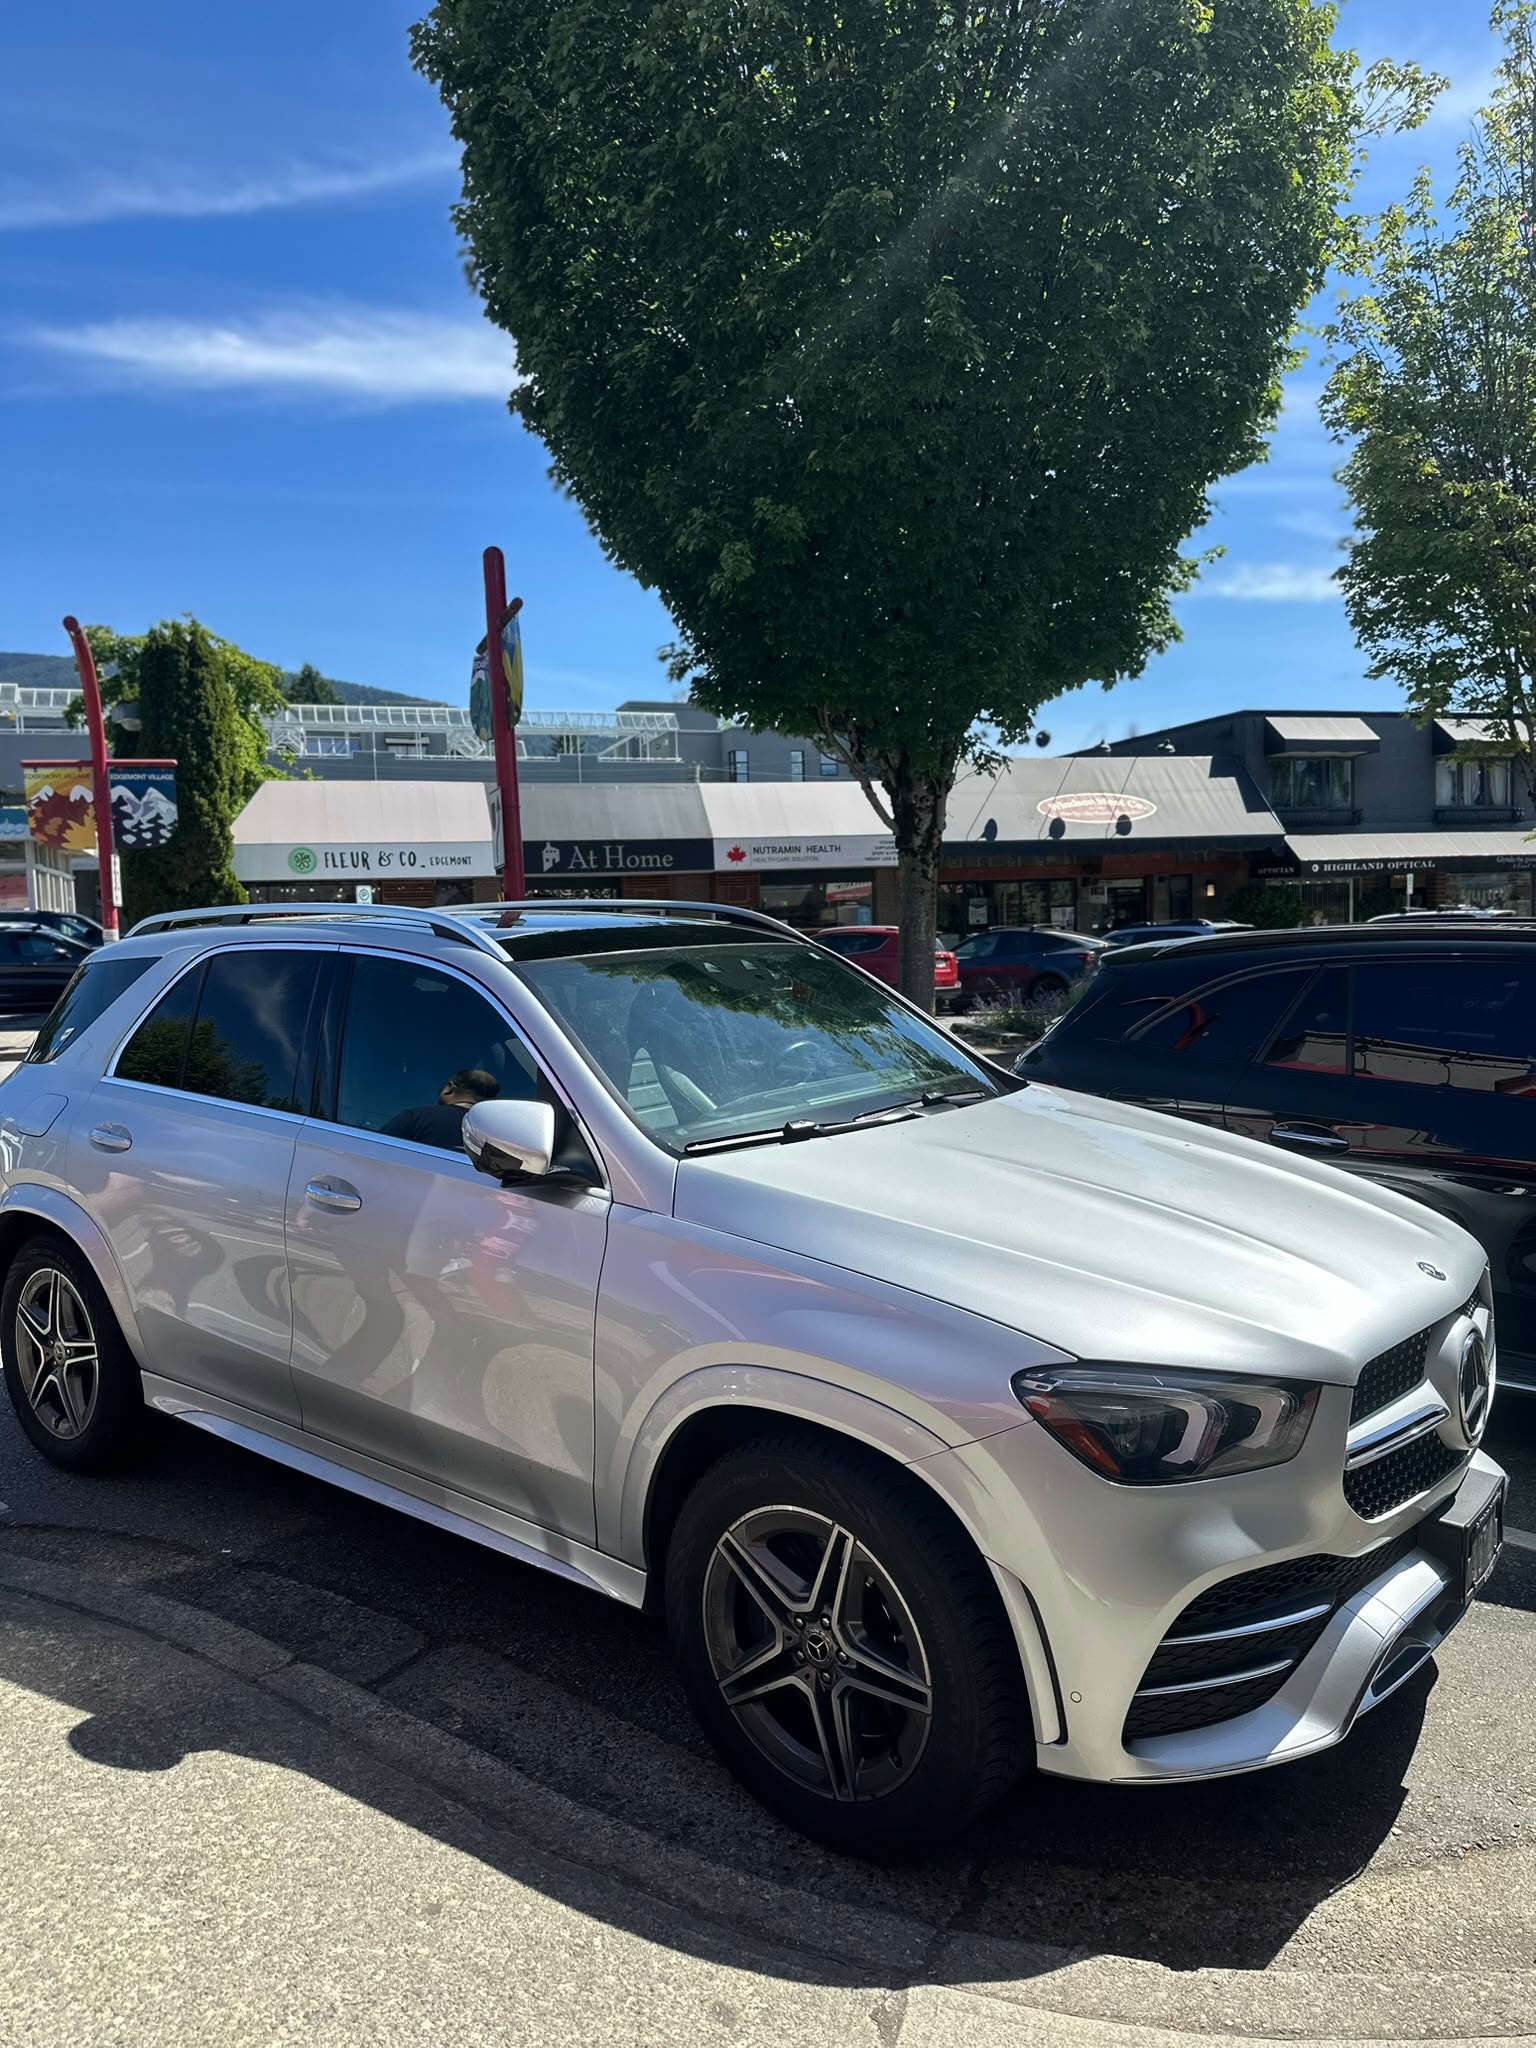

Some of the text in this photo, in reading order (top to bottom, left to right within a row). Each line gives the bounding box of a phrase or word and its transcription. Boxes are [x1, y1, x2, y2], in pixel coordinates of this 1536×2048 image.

[752, 843, 841, 855] NUTRAMIN HEALTH
[324, 851, 370, 870] FLEUR
[378, 850, 394, 867] &
[429, 856, 471, 866] EDGEMONT
[567, 845, 674, 869] At Home
[1257, 867, 1295, 875] OPTICIAN
[1323, 860, 1436, 872] HIGHLAND OPTICAL
